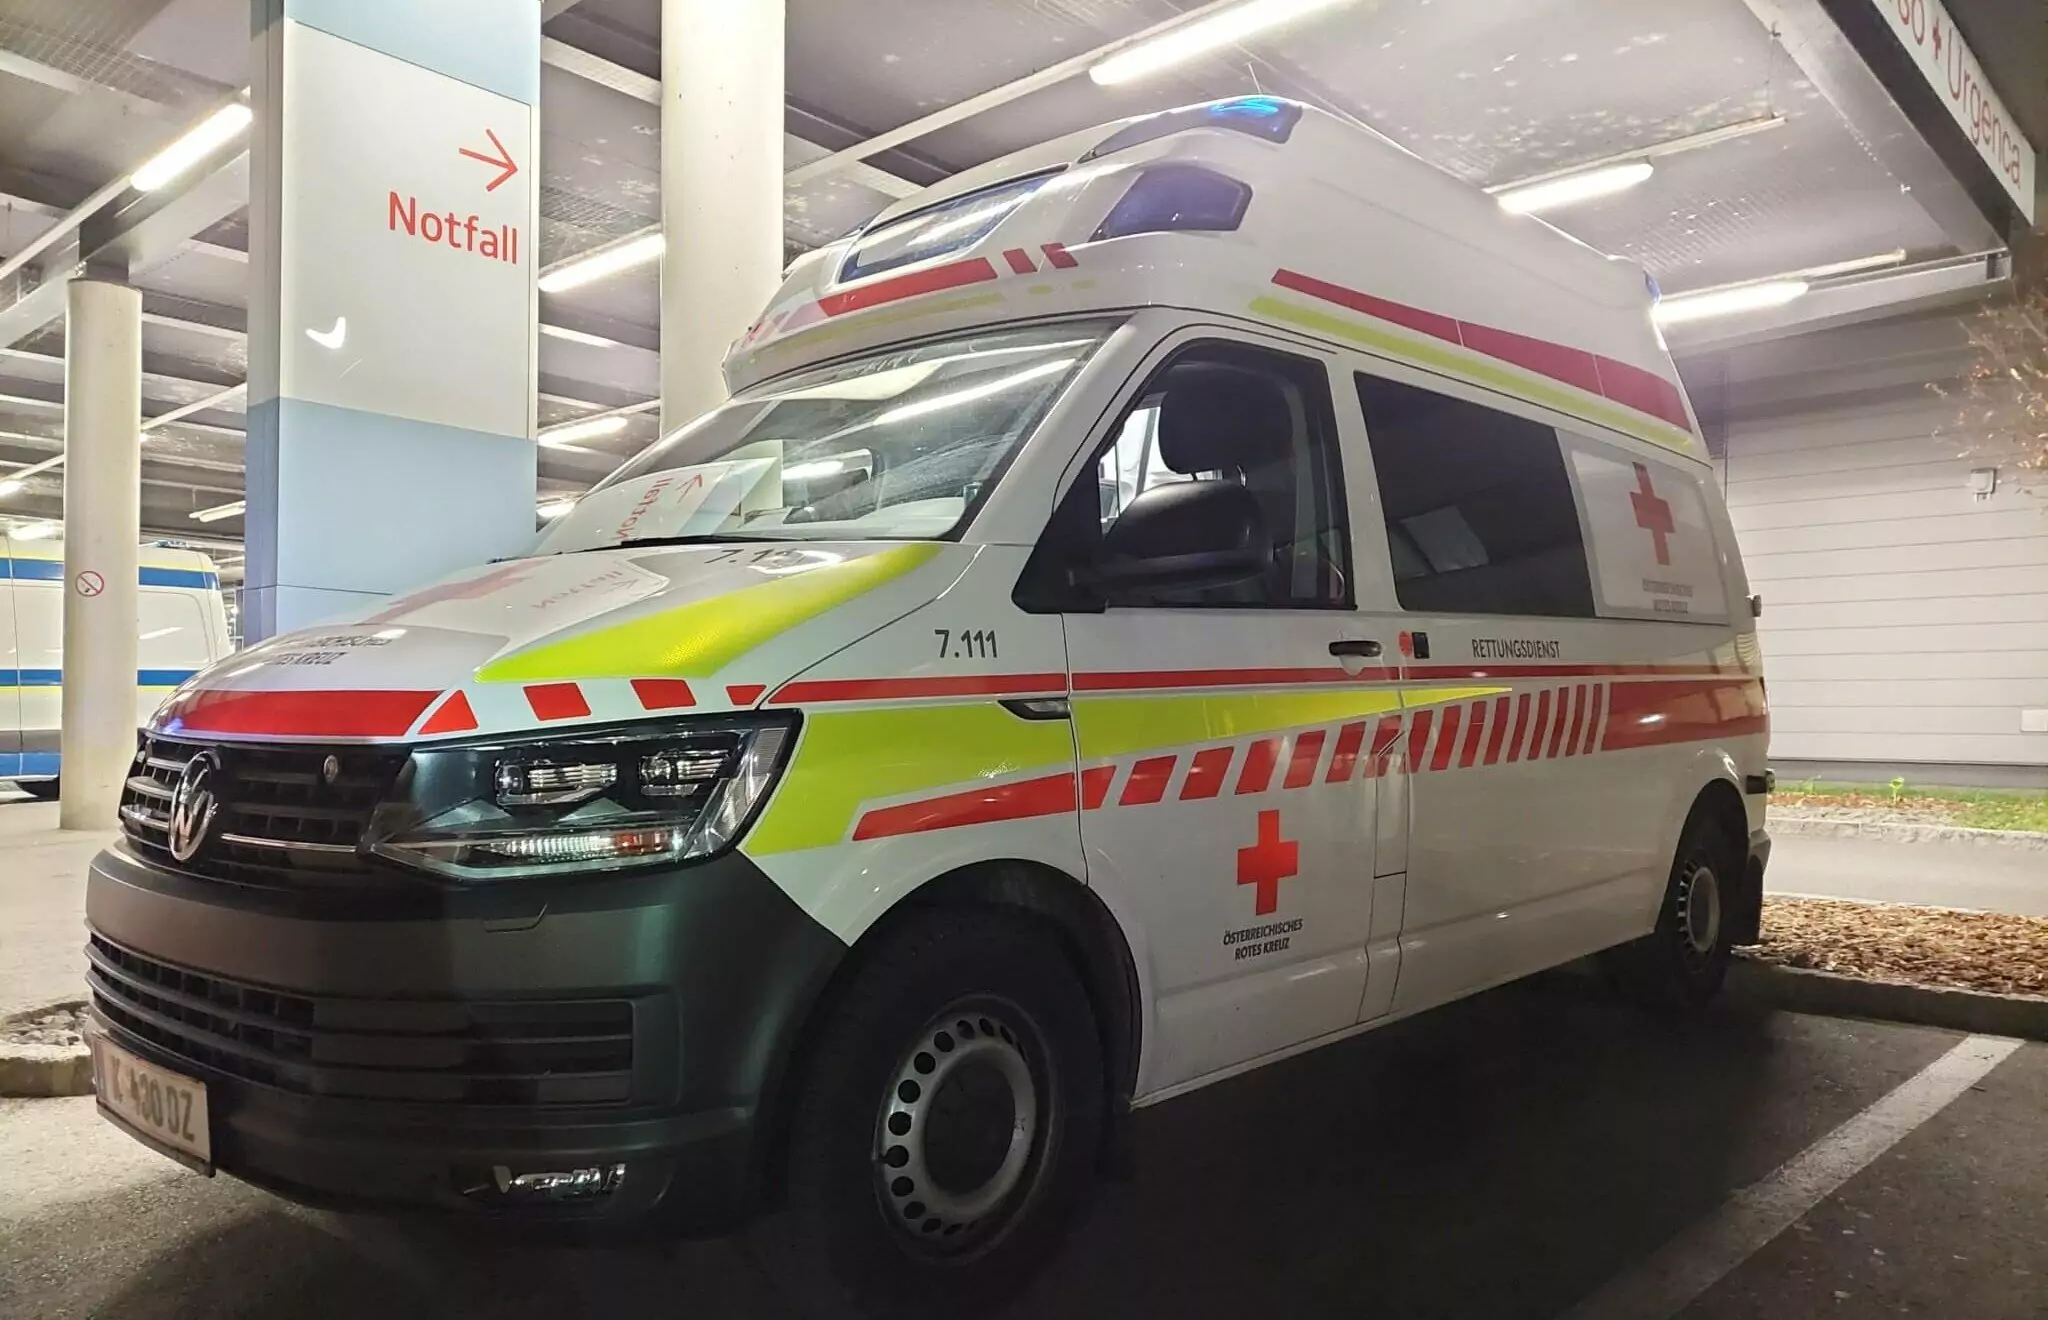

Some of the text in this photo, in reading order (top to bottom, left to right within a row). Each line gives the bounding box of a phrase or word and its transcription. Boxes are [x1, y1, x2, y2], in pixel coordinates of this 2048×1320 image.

[1948, 25, 2021, 190] Urgenca
[389, 190, 517, 265] Notfall
[703, 547, 800, 565] 7.1
[934, 628, 998, 659] 7.111
[1472, 638, 1560, 660] RETTUNGSDIENST
[1223, 918, 1304, 946] ÖSTERREICHISCHES
[1234, 936, 1291, 961] ROTES KREUZ
